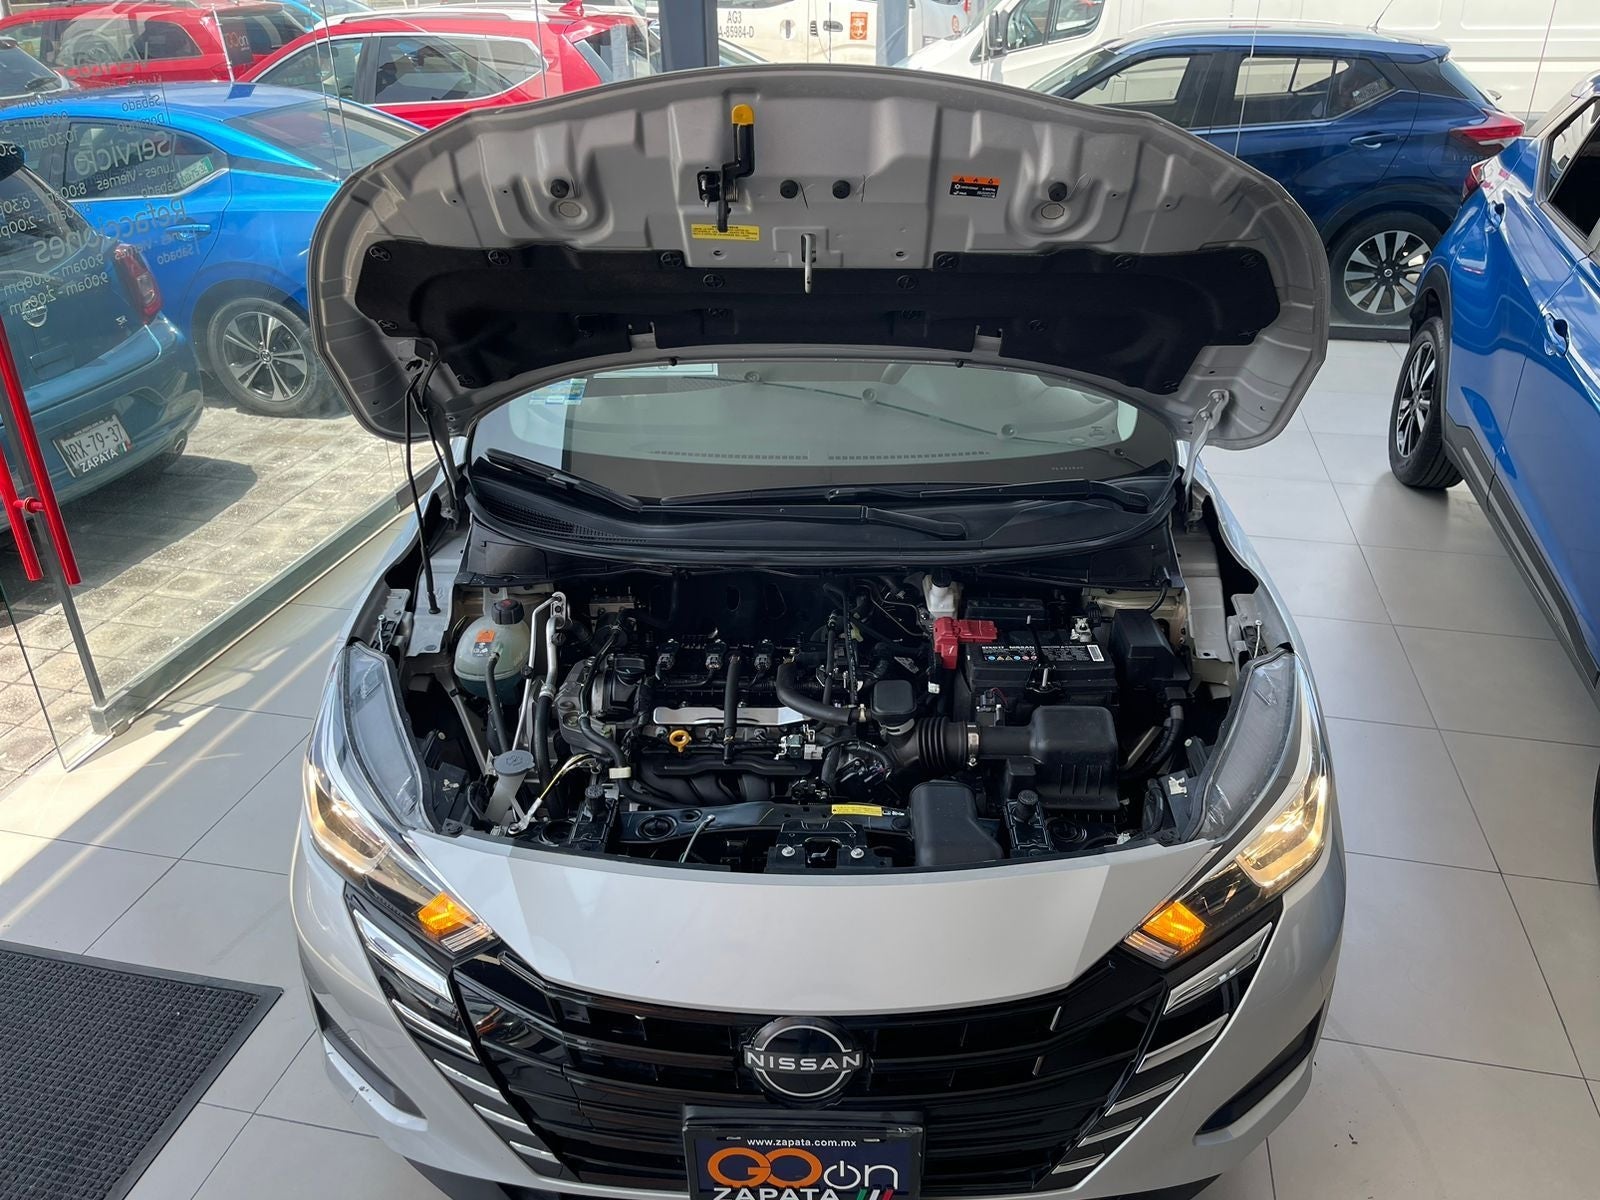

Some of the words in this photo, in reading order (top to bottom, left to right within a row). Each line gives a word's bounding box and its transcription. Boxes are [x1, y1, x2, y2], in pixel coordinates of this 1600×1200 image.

[727, 11, 742, 24] AG3
[79, 448, 119, 473] ZAPATA
[747, 1052, 860, 1071] NISSAN
[746, 1138, 857, 1148] www.zapata.com.mx
[713, 1187, 840, 1200] ZAPATA
